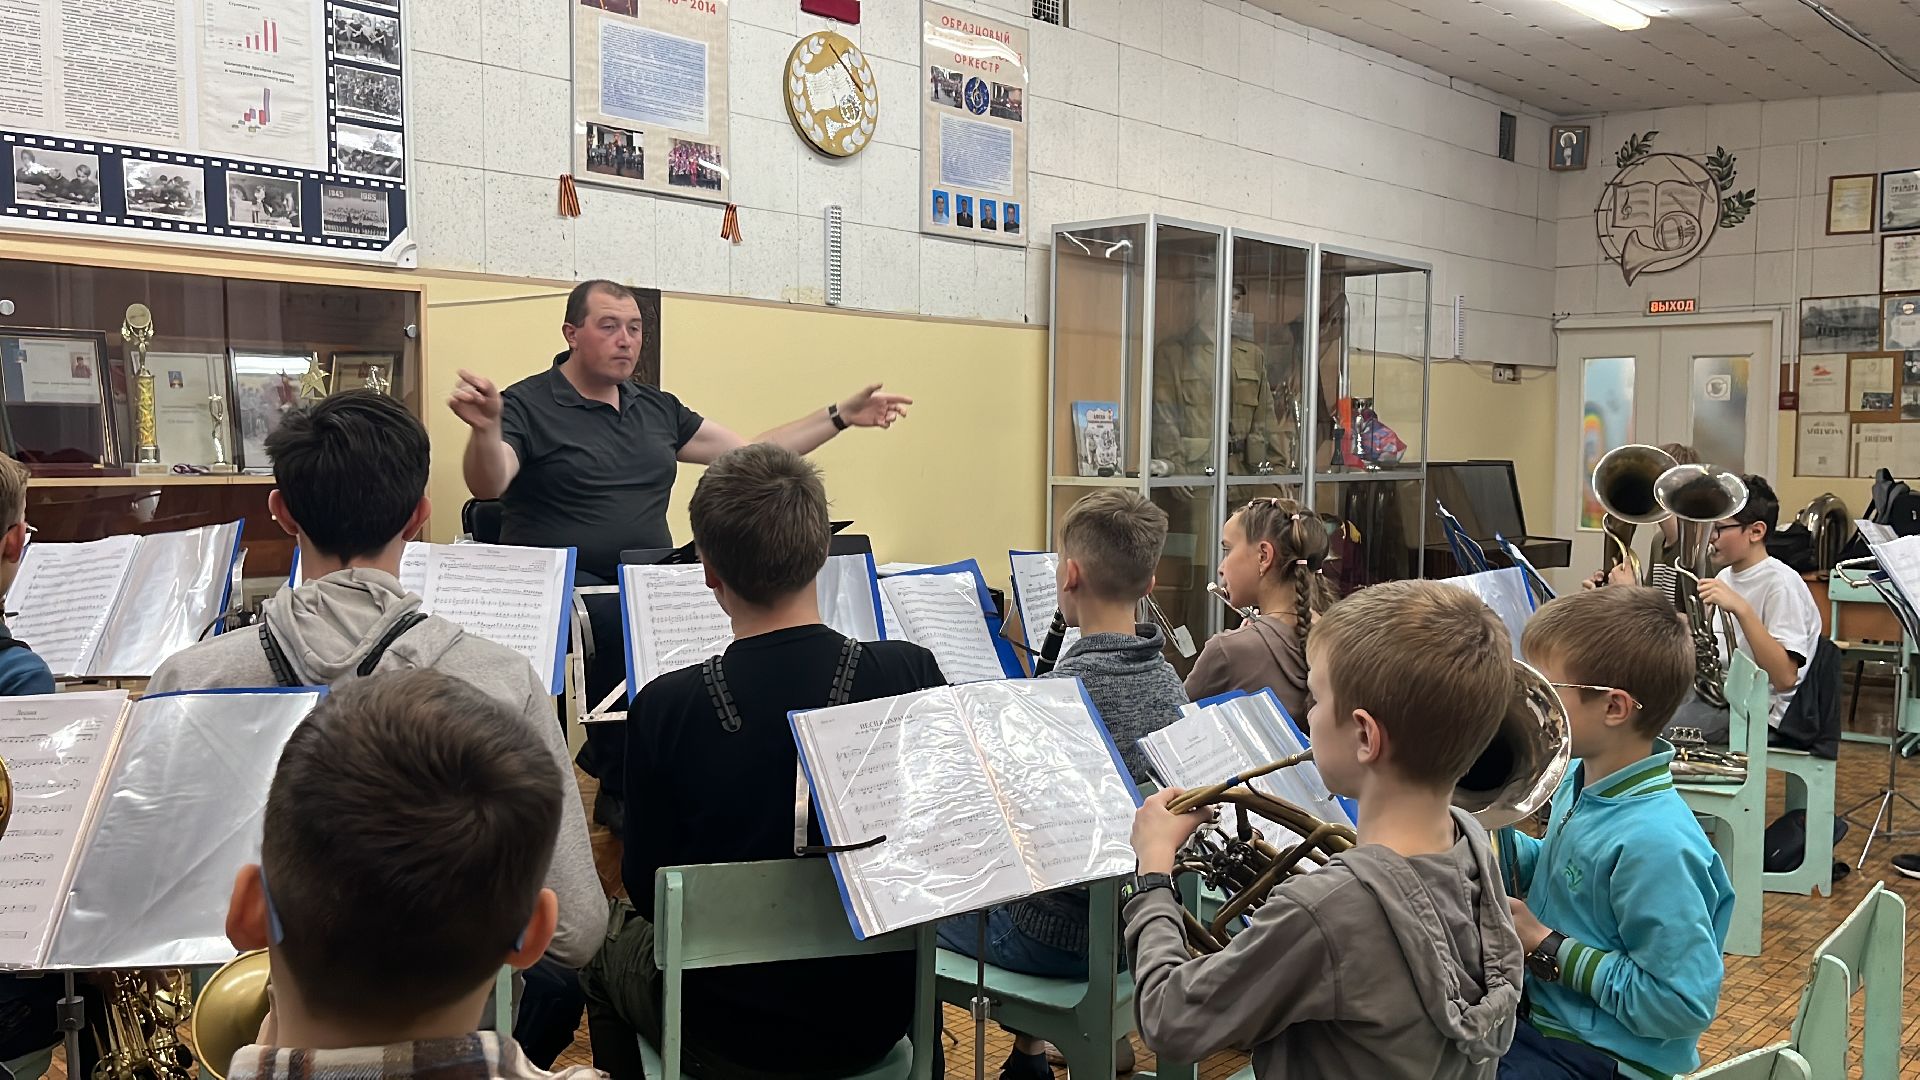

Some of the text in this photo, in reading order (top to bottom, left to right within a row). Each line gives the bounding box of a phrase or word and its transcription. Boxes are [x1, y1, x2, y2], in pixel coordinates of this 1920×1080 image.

[941, 15, 1010, 44] ОБРАЗЦОВЫЙ
[954, 53, 1000, 74] ОРКЕСТР
[328, 189, 344, 198] 1945
[360, 192, 377, 201] 1985
[1650, 300, 1694, 312] ВЫХОД
